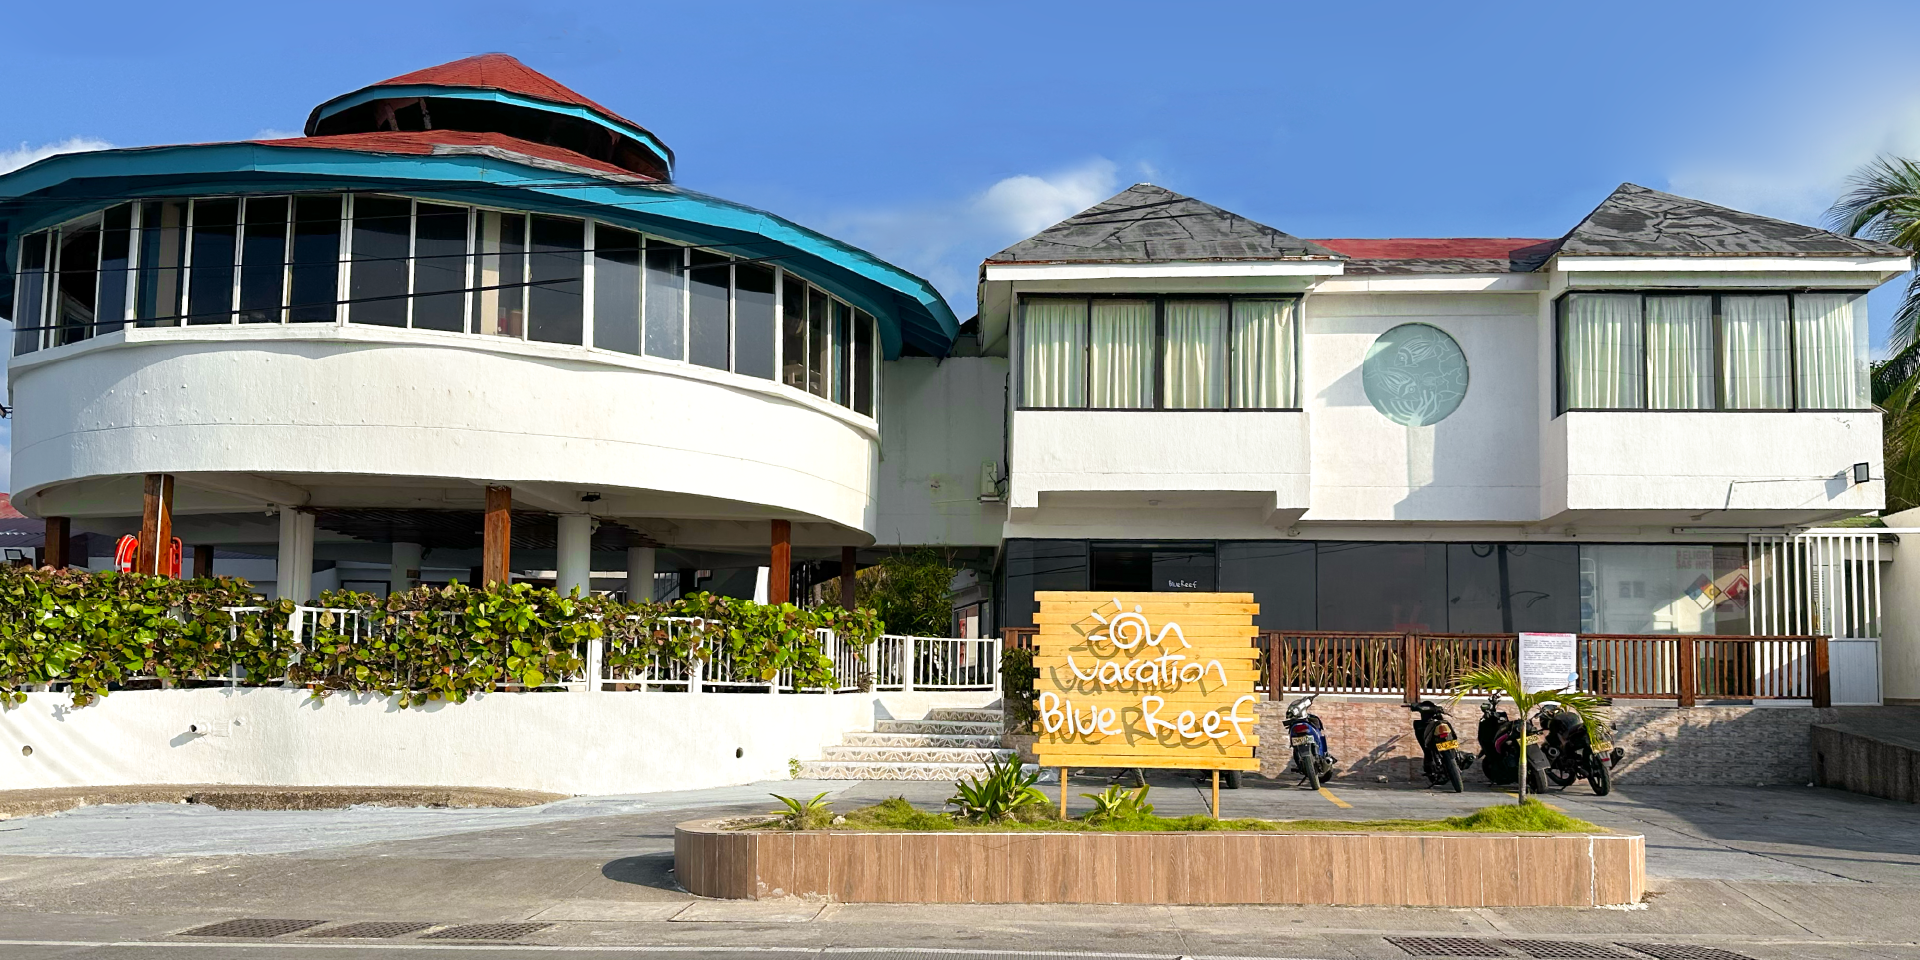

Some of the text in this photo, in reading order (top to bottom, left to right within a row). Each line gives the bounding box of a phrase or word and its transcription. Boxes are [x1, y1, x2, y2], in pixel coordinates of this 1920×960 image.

[1109, 611, 1192, 649] On
[1067, 647, 1228, 687] vacation
[1039, 691, 1256, 745] Blue Reef
